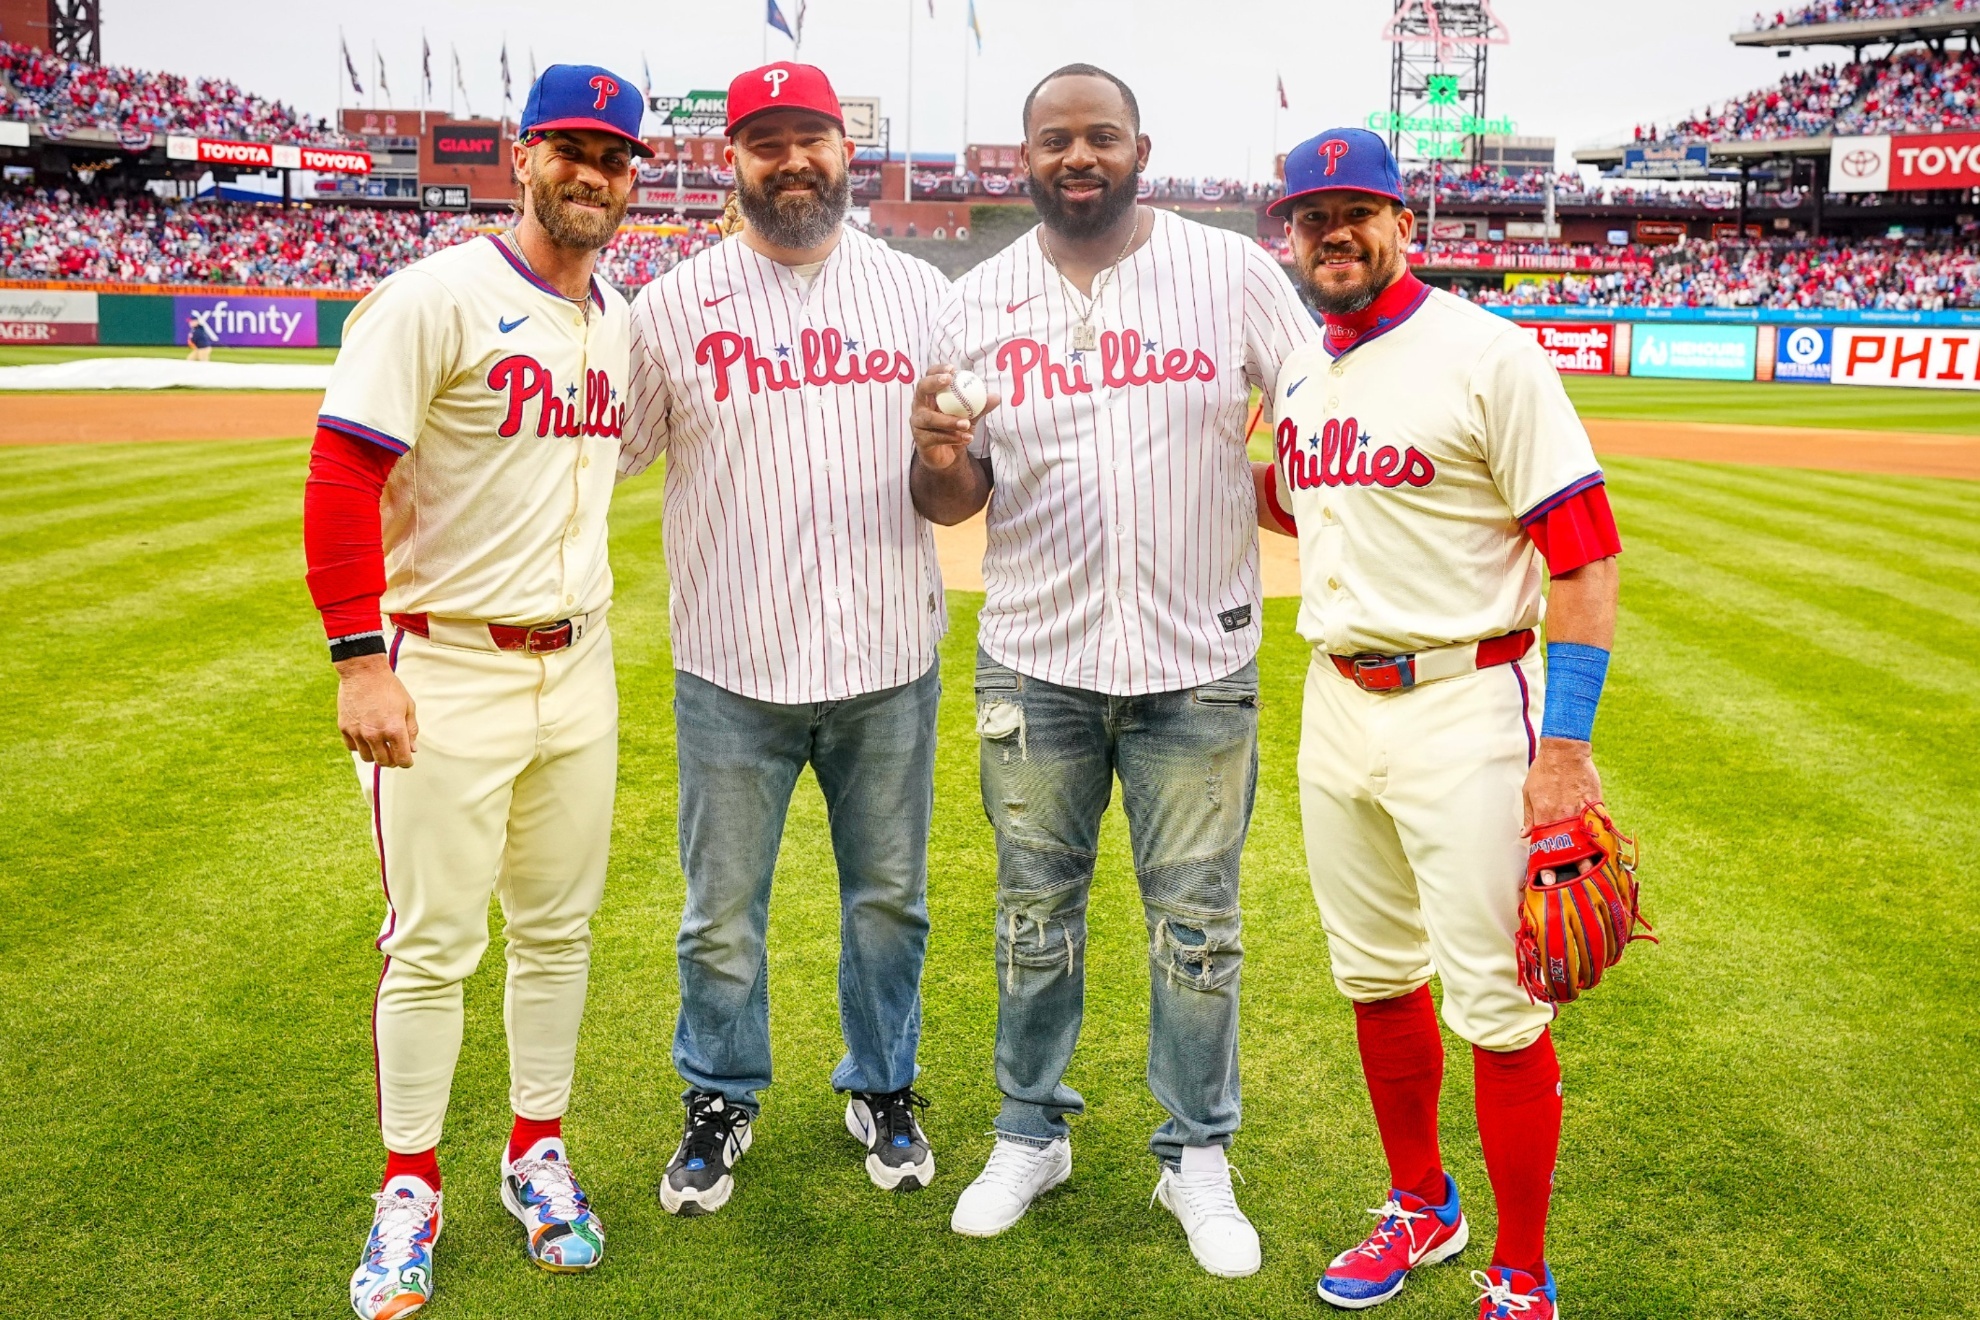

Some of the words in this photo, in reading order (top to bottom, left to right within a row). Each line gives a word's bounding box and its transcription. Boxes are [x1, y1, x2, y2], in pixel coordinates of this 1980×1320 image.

[589, 74, 620, 110] P
[763, 68, 789, 98] P
[655, 98, 680, 111] CP
[672, 116, 726, 126] ROOFTOP
[1368, 112, 1456, 132] Citizens
[1461, 114, 1514, 135] Bank
[201, 142, 270, 163] TOYOTA
[438, 138, 494, 153] GIANT
[1318, 139, 1349, 176] P
[1417, 138, 1464, 157] Park
[303, 151, 367, 171] TOYOTA
[191, 300, 303, 342] xfinity
[1541, 327, 1609, 349] Temple
[695, 327, 915, 402] Phillies
[996, 328, 1216, 407] Phillies
[1846, 335, 1980, 382] PHI
[1277, 416, 1436, 492] Phillies
[577, 624, 583, 639] 3
[1552, 956, 1566, 984] A2X
